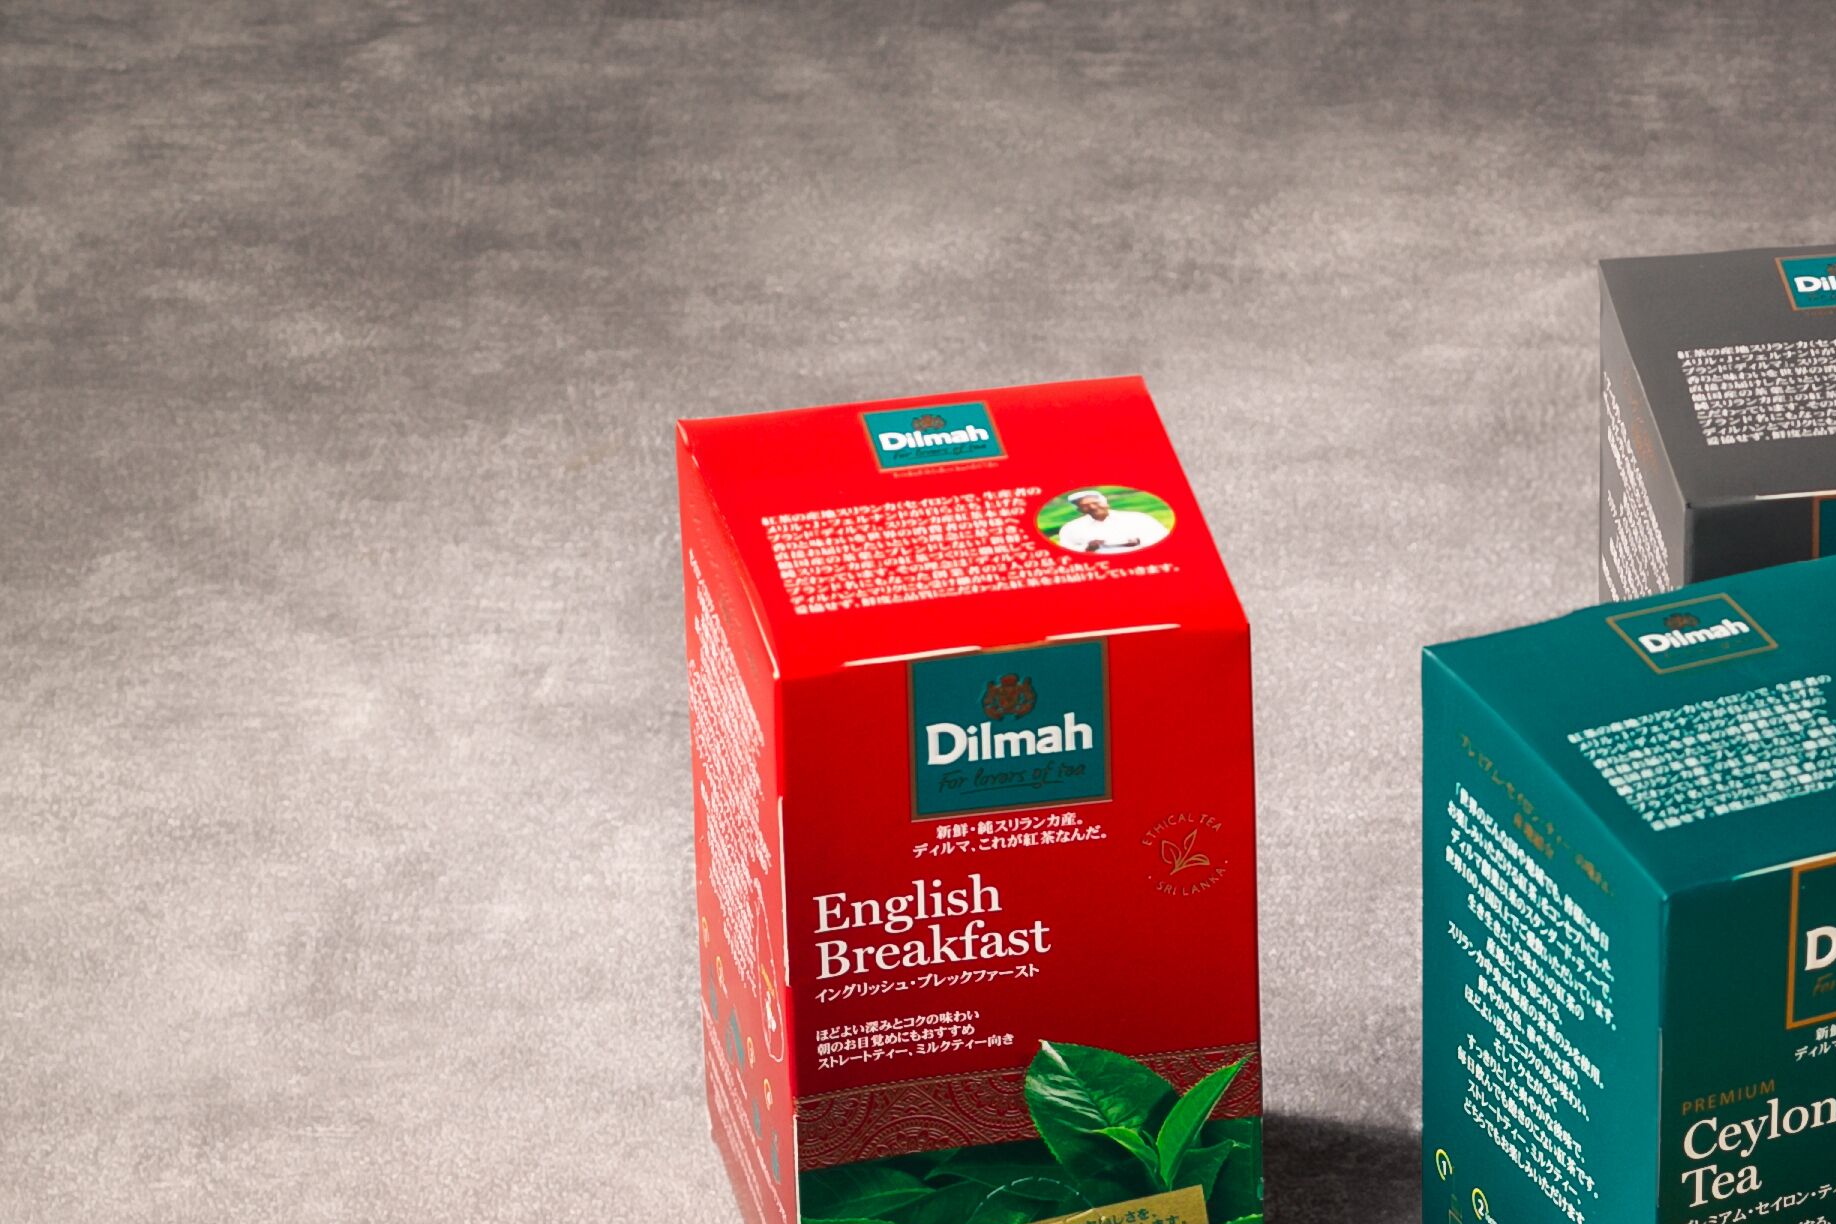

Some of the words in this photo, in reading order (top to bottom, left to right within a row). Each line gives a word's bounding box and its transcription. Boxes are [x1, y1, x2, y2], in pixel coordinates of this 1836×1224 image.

[878, 424, 990, 451] Dilmah
[1638, 615, 1752, 655] Dilmah
[926, 712, 1093, 766] Dilmah
[938, 769, 969, 793] For
[1057, 761, 1087, 778] tea
[912, 824, 1108, 859] ディルマ、これが紅茶なんだ。
[936, 812, 1084, 840] 新鮮・純スリランカ産。
[1141, 813, 1194, 847] ETHICAL
[1199, 813, 1222, 832] TEA
[1156, 881, 1177, 896] SRI
[1182, 868, 1227, 896] LANKA
[812, 873, 1003, 935] English
[816, 919, 1052, 980] Breakfast
[815, 963, 1040, 1003] イングリッシュ・ブレックファースト
[816, 1008, 980, 1042] ほどよい深みとコクの味わい
[817, 1022, 976, 1057] 朝のお目覚めにもおすすめ
[817, 1032, 1015, 1071] ストレートティー、ミルクティー向き
[1681, 1079, 1777, 1116] PREMIUM
[1681, 1163, 1764, 1208] Tea
